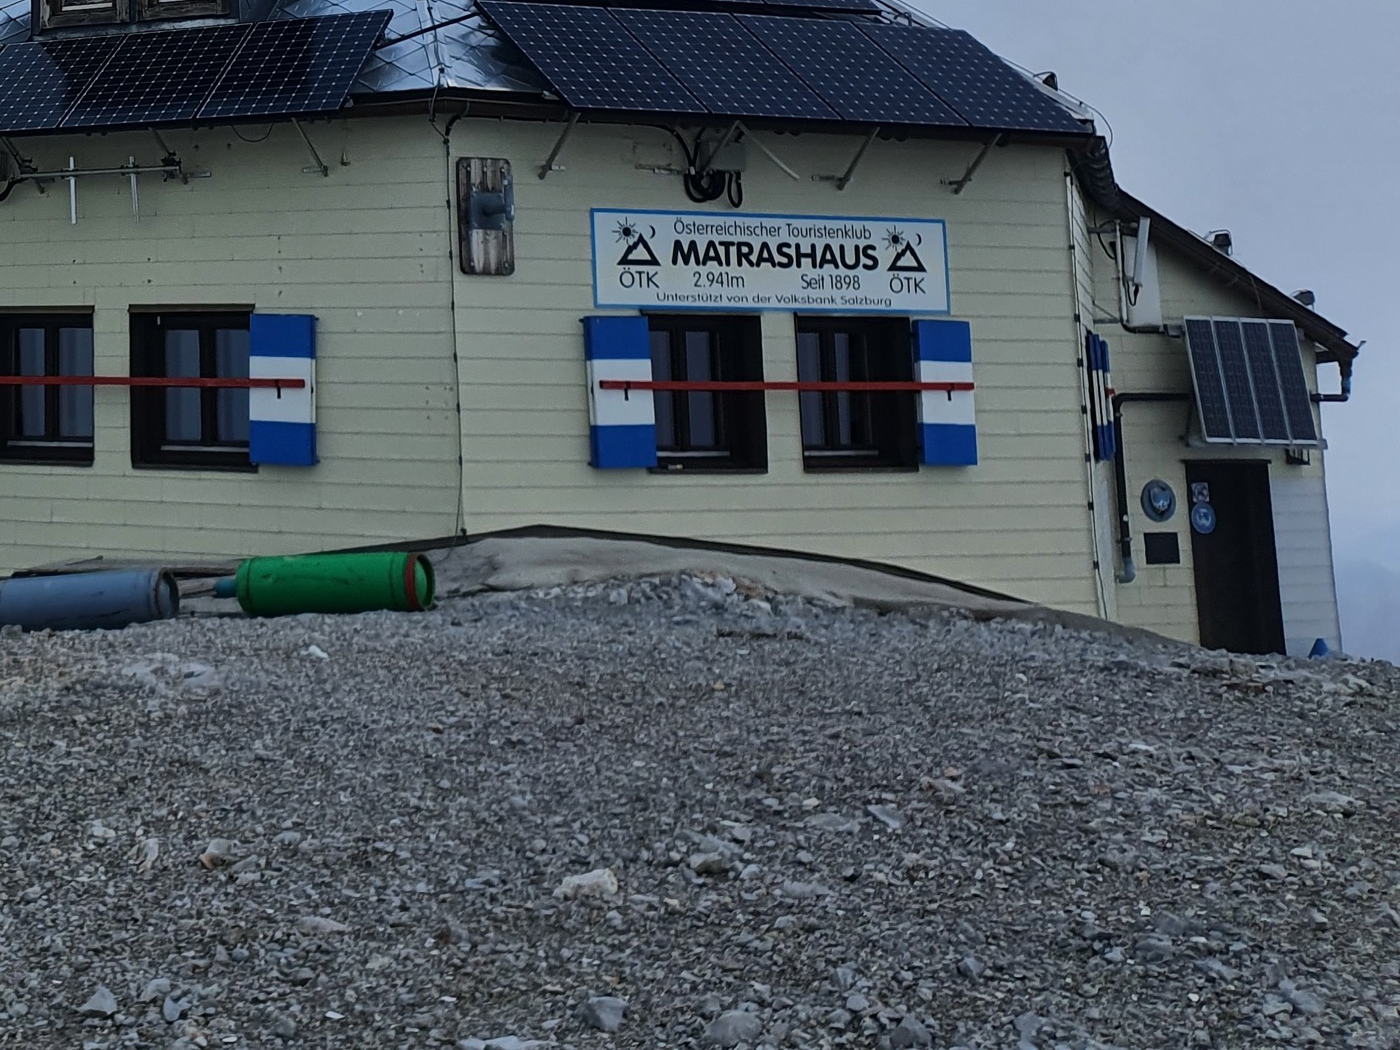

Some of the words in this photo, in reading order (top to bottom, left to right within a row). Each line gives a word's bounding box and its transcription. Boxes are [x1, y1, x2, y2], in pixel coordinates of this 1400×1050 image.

[673, 217, 781, 238] Österreichischer
[786, 223, 872, 240] Touristenklub
[671, 239, 879, 271] MATRASHAUS
[619, 267, 660, 289] ÖTK
[693, 271, 745, 288] 2.941m
[800, 273, 825, 290] Seit
[828, 274, 861, 291] 1898
[889, 273, 926, 294] ÖTK
[656, 292, 723, 303] Unterstützt
[727, 295, 748, 303] von
[752, 293, 772, 304] der
[775, 294, 838, 305] Volksbank
[840, 295, 892, 307] Salzburg
